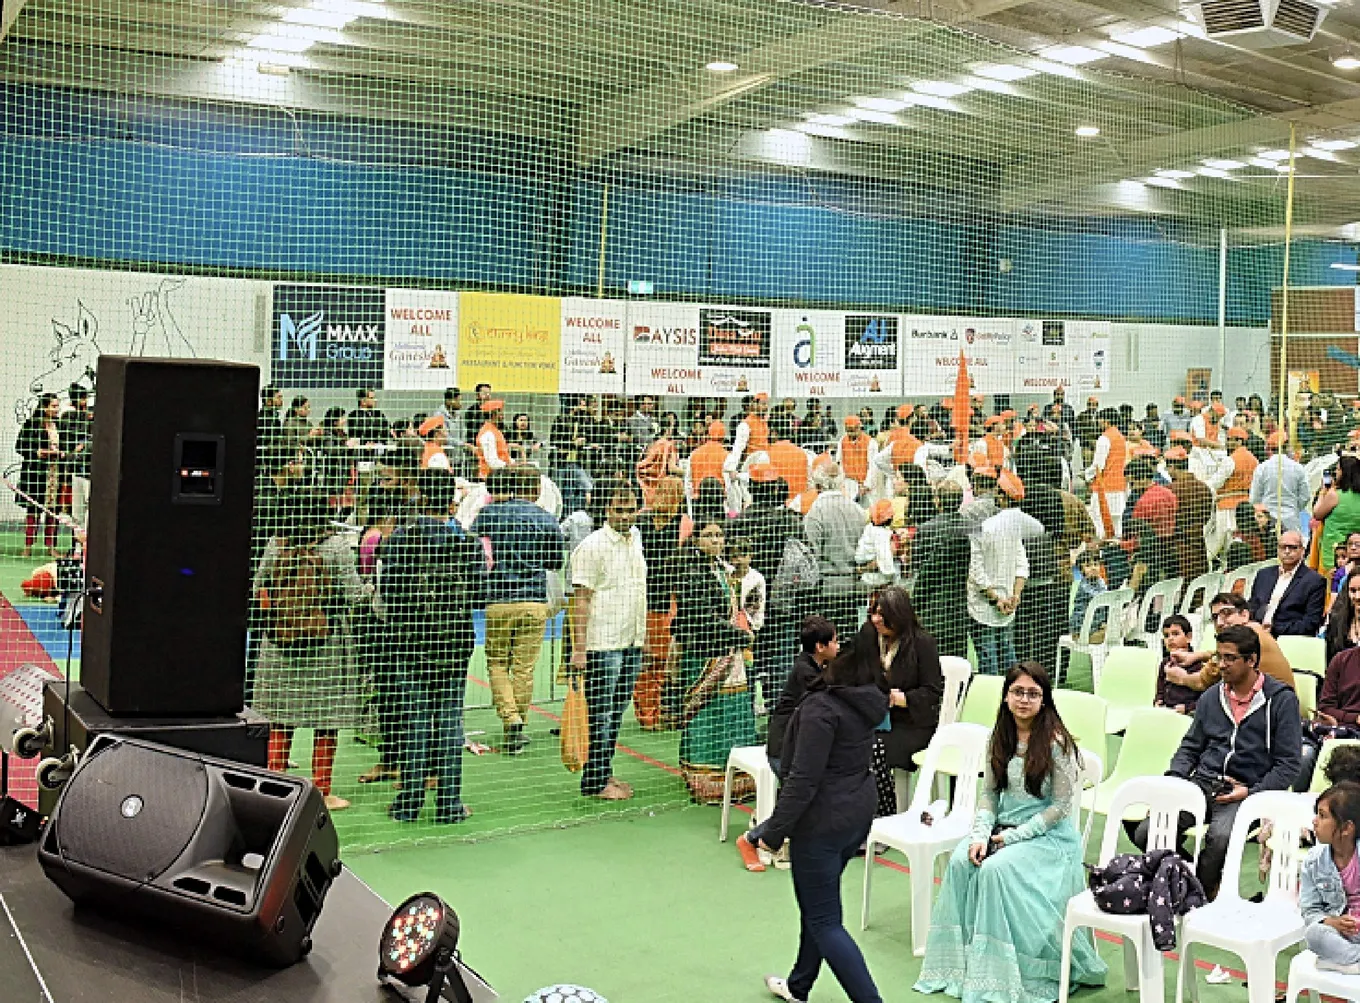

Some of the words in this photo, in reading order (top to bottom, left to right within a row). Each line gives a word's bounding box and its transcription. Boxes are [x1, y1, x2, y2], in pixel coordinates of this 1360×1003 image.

[391, 308, 452, 322] WELCOME
[565, 318, 620, 329] WELCOME
[327, 324, 378, 342] MAAX
[411, 325, 432, 336] ALL
[583, 332, 602, 344] ALL
[327, 343, 372, 360] Group
[651, 368, 703, 379] WELCOME
[795, 372, 840, 382] WELCOME
[668, 383, 685, 393] ALL
[810, 386, 825, 396] ALL
